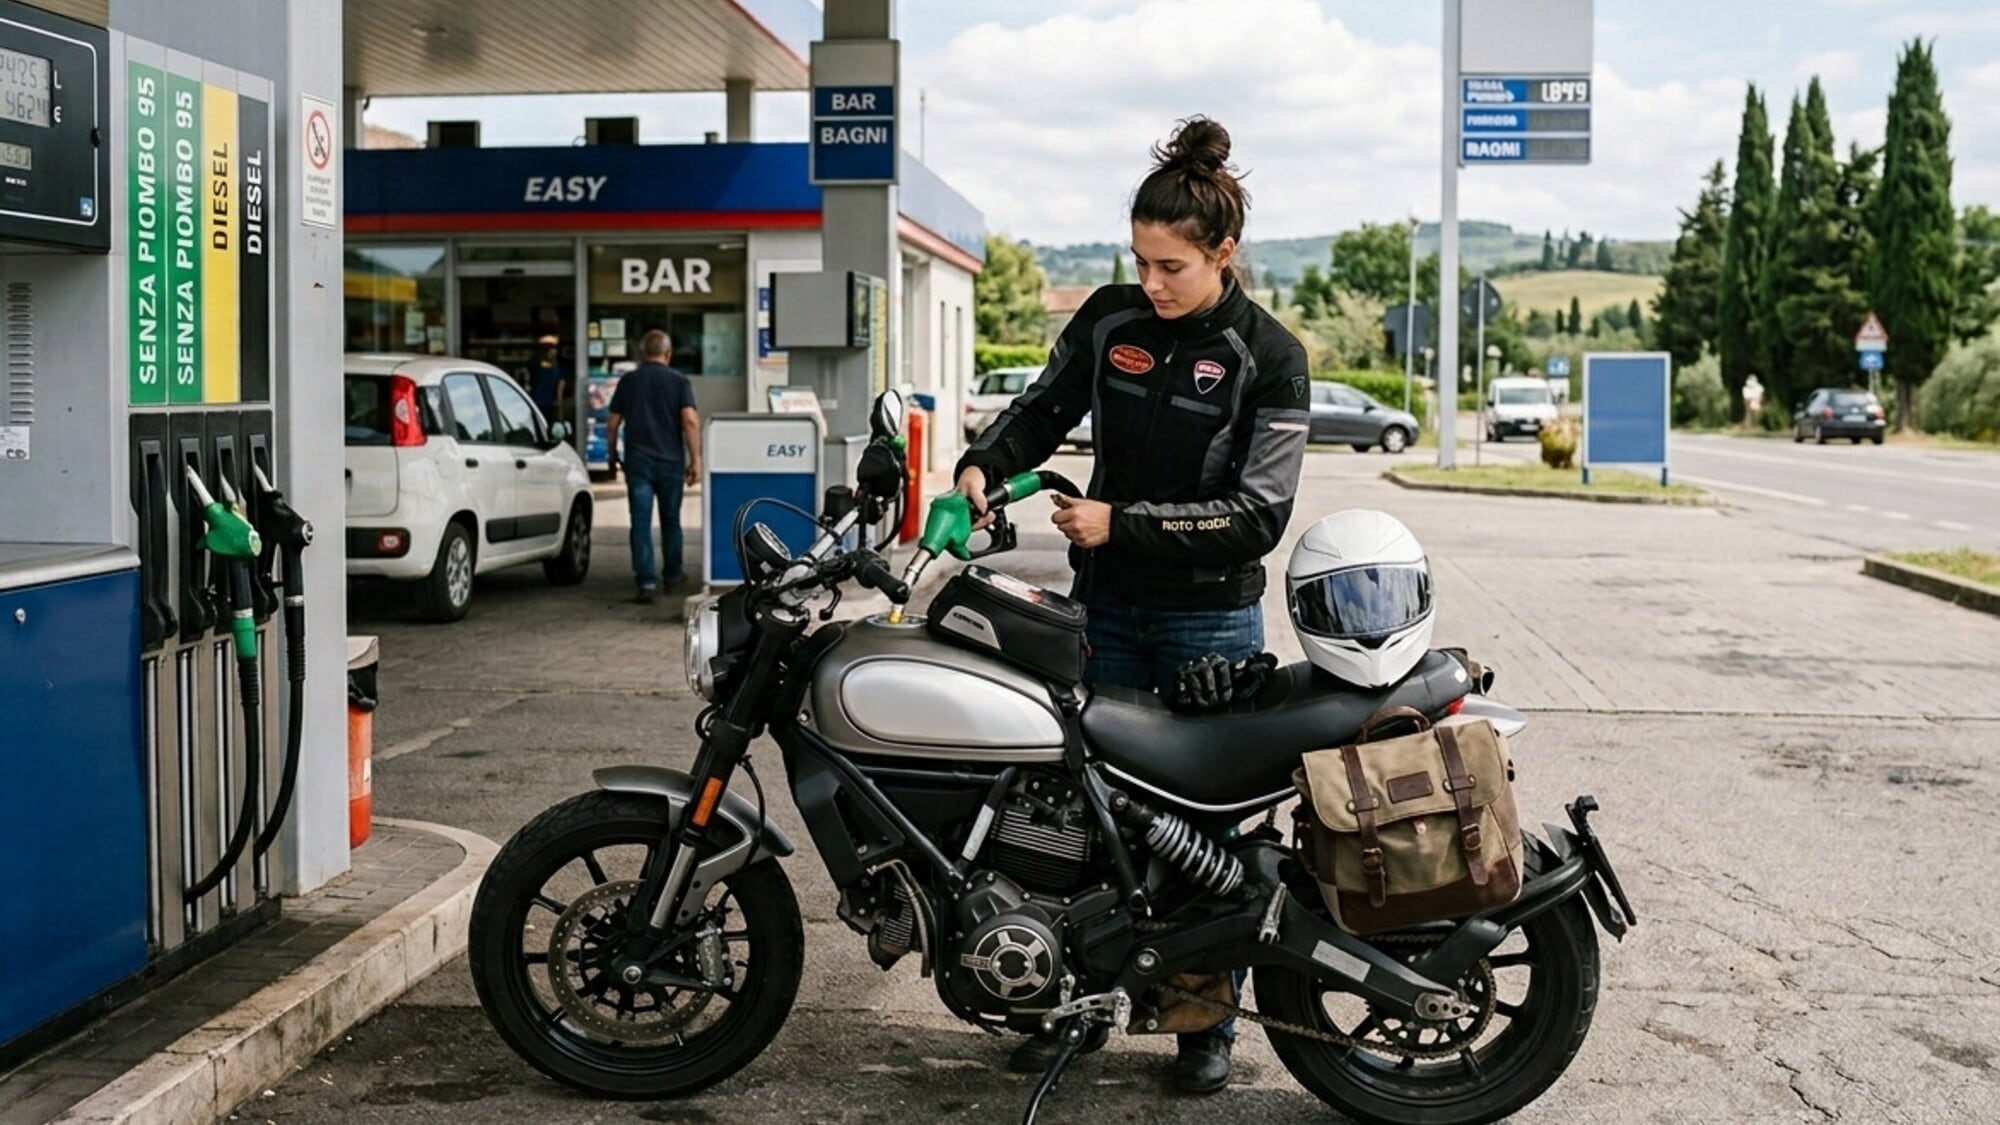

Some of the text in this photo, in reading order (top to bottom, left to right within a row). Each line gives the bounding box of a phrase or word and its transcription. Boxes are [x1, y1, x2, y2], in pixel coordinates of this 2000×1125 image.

[831, 92, 876, 111] BAR
[821, 126, 888, 145] BAGNI
[212, 142, 229, 251] DIESEL
[247, 149, 263, 255] DIESEL
[523, 176, 608, 202] EASY
[138, 76, 157, 385] SENZA PIOMBO 95
[175, 90, 195, 385] SENZA PIOMBO 95
[621, 257, 712, 294] BAR
[766, 443, 807, 459] EASY
